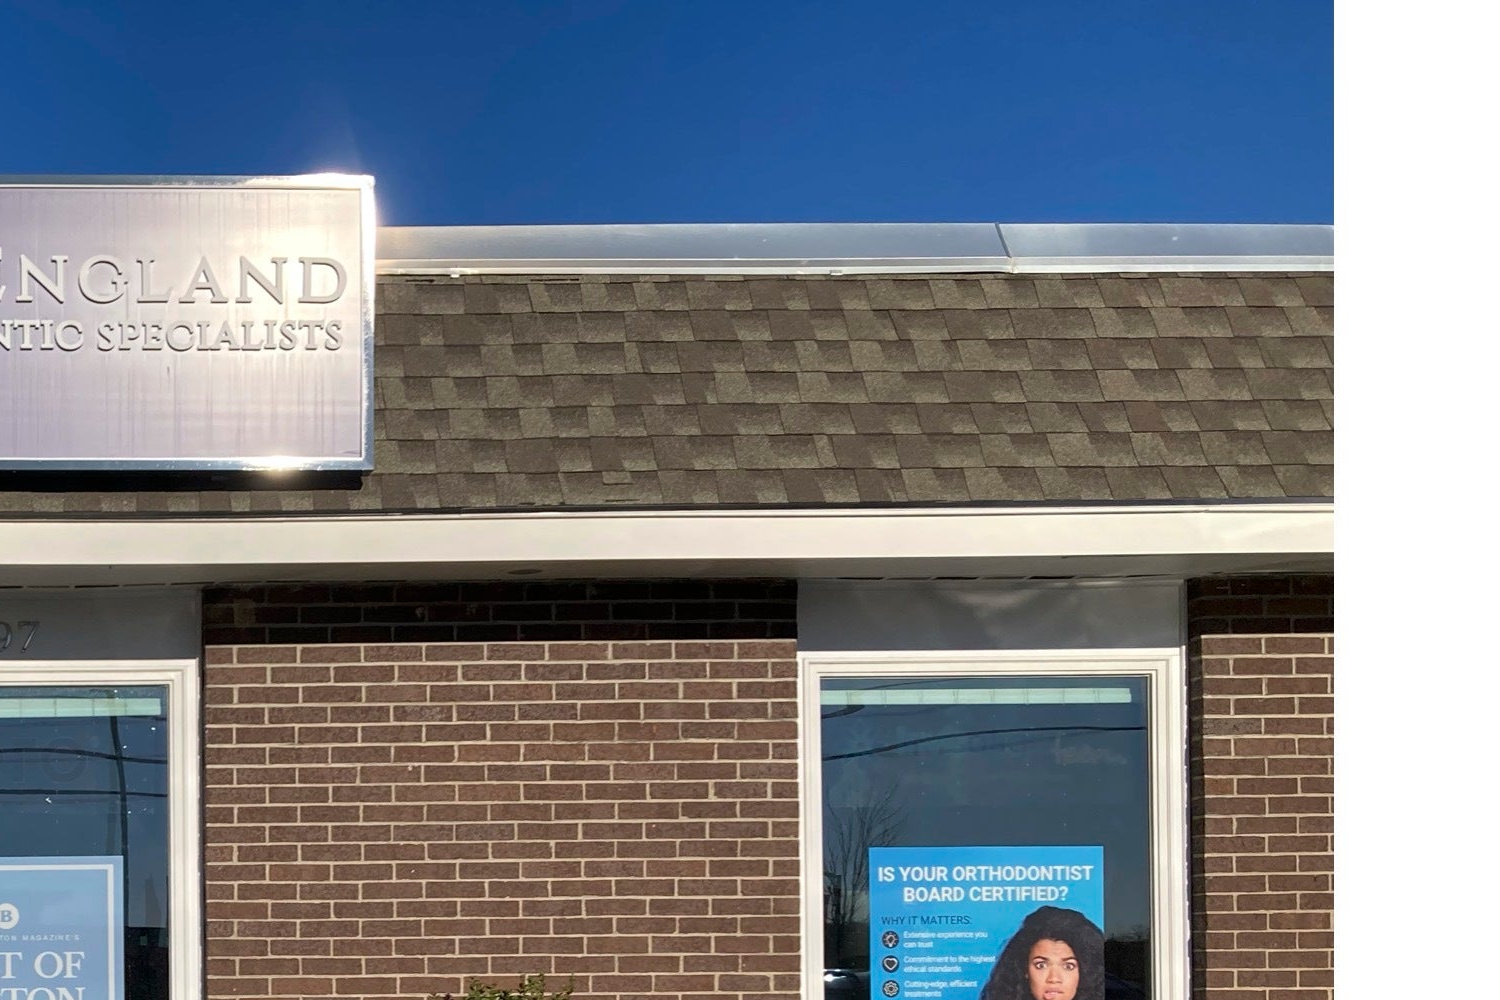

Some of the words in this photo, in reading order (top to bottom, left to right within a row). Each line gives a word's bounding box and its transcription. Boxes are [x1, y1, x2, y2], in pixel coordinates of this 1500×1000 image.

[95, 317, 345, 352] SPECIALISTS
[878, 867, 895, 882] IS
[899, 866, 948, 882] YOUR
[952, 865, 1094, 881] ORTHODONTIST
[903, 886, 965, 902] BOARD
[969, 886, 1069, 902] CERTIFIED?
[0, 910, 13, 922] B
[881, 916, 905, 925] WHY
[908, 916, 917, 925] IT
[921, 915, 972, 925] MATTERS:
[34, 951, 85, 979] OF
